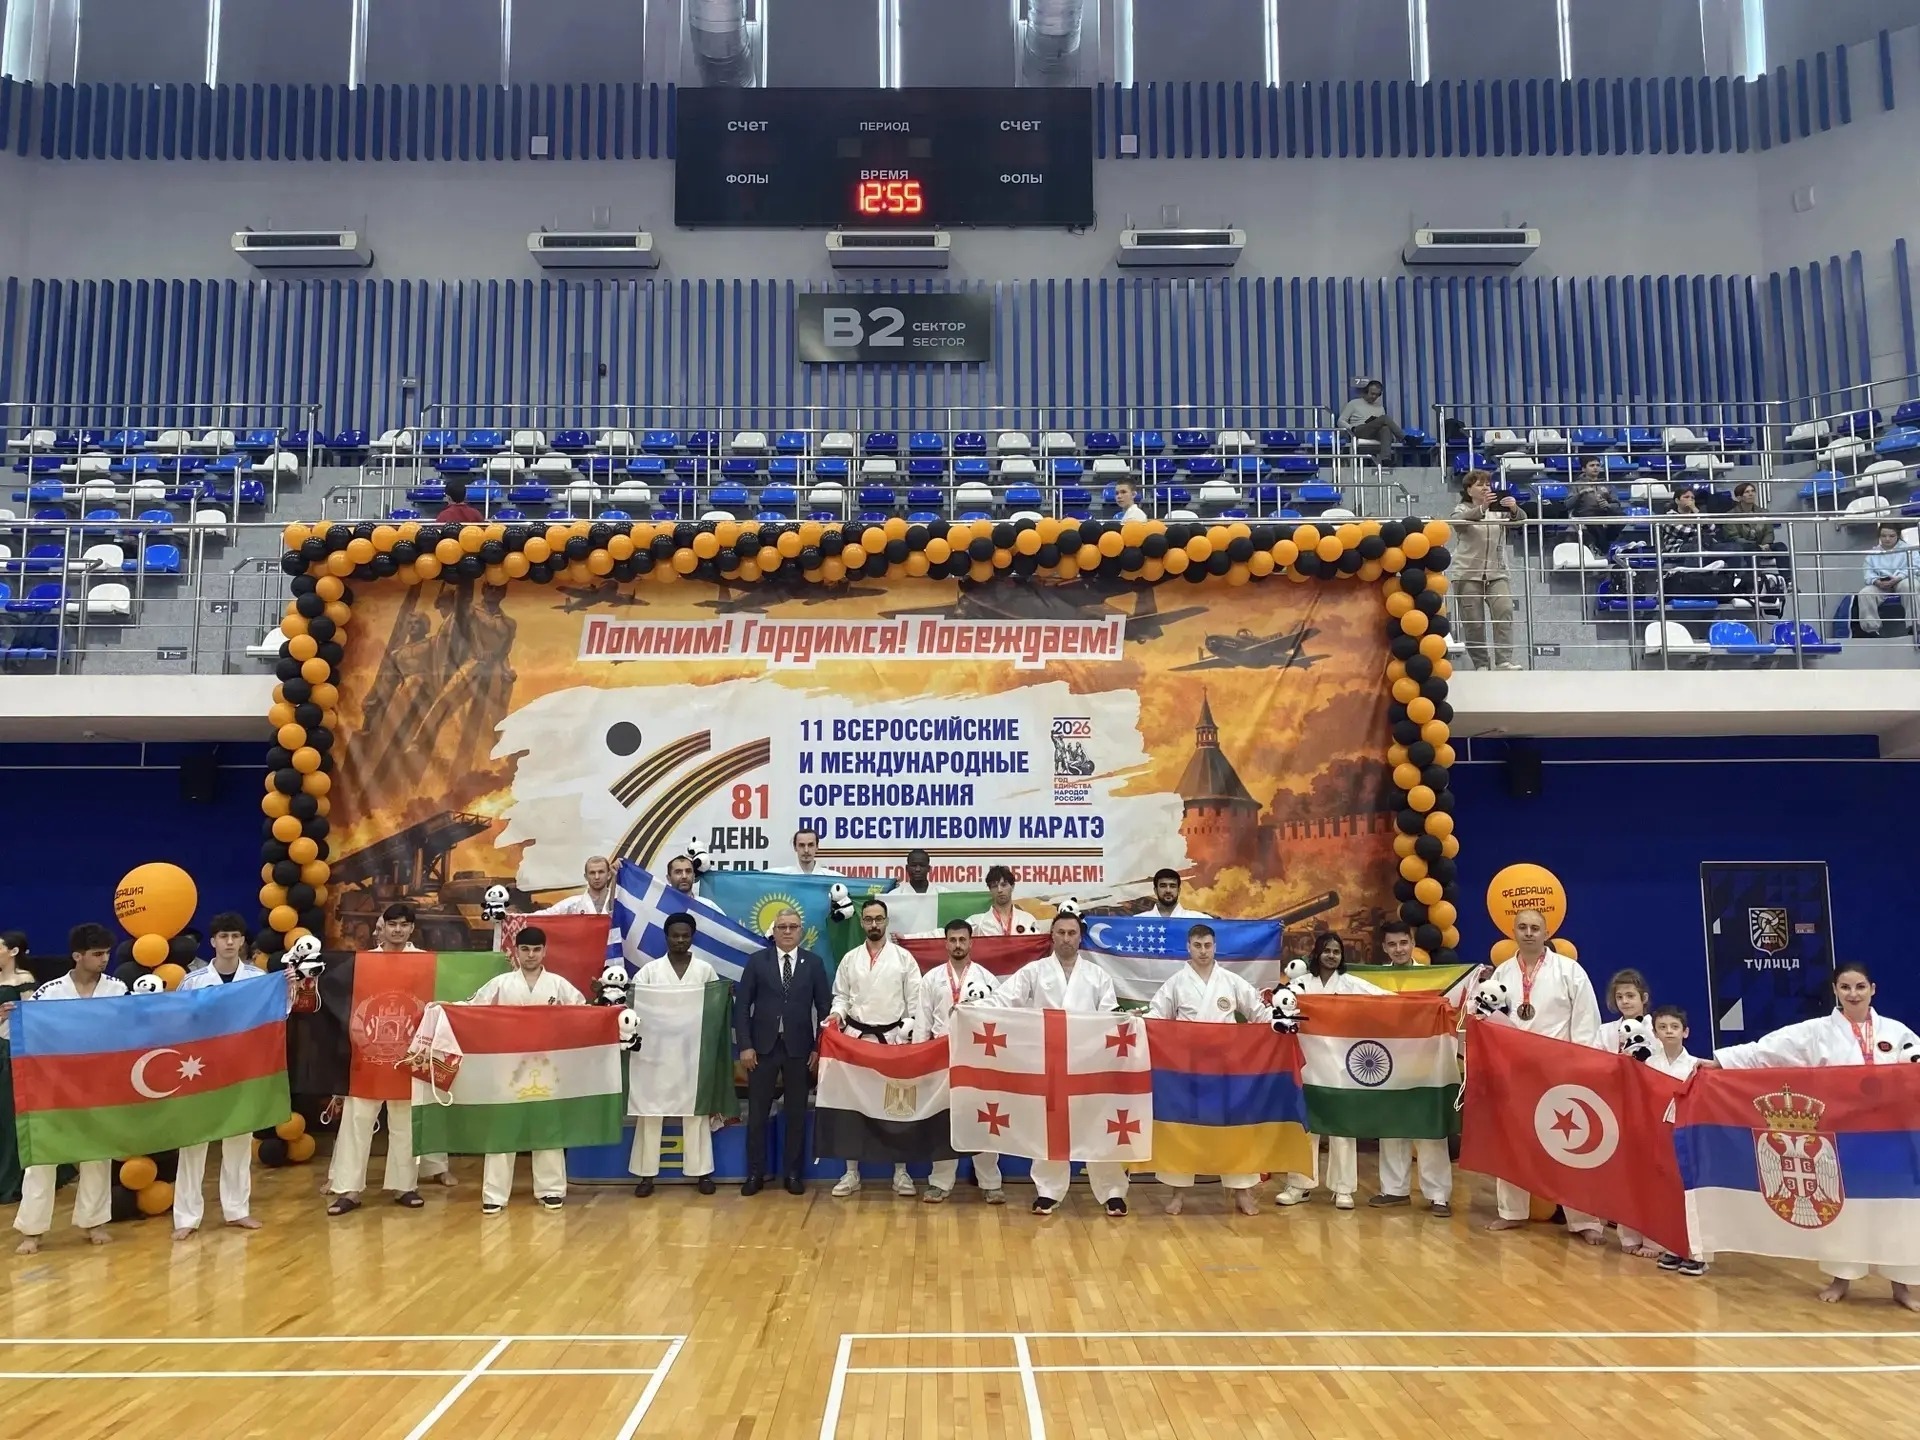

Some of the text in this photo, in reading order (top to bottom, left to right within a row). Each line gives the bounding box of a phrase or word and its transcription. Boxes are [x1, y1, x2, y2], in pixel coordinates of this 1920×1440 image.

[859, 121, 910, 133] ПЕРИОД
[726, 173, 769, 185] ФОЛЫ
[860, 170, 909, 180] ВРЕМЯ
[1000, 173, 1043, 184] ФОЛЫ
[858, 182, 922, 213] 12:55
[912, 322, 966, 331] СЕКТОР
[912, 337, 966, 347] SECTOR
[585, 619, 1119, 663] Помним! Гордимся! Побеждаем!
[800, 716, 1019, 741] 11 ВСЕРОССИЙСКИЕ
[1053, 721, 1091, 735] 2026
[799, 751, 1029, 777] И МЕЖДУНАРОДНЫЕ
[731, 784, 769, 820] 81
[799, 784, 974, 806] СОРЕВНОВАНИЯ
[835, 816, 1012, 839] ВСЕСТИЛЕВОМУ
[1019, 816, 1105, 839] КАРАТЭ
[708, 827, 769, 853] ДЕНЬ
[886, 866, 982, 882] ГОИМСЯ!
[990, 866, 1104, 885] БЕЖДАЕМ!
[1501, 886, 1554, 898] ФЕДЕРАЦИЯ
[1511, 897, 1546, 908] КАРАТЭ
[1743, 958, 1800, 971] ТУЛИЦА
